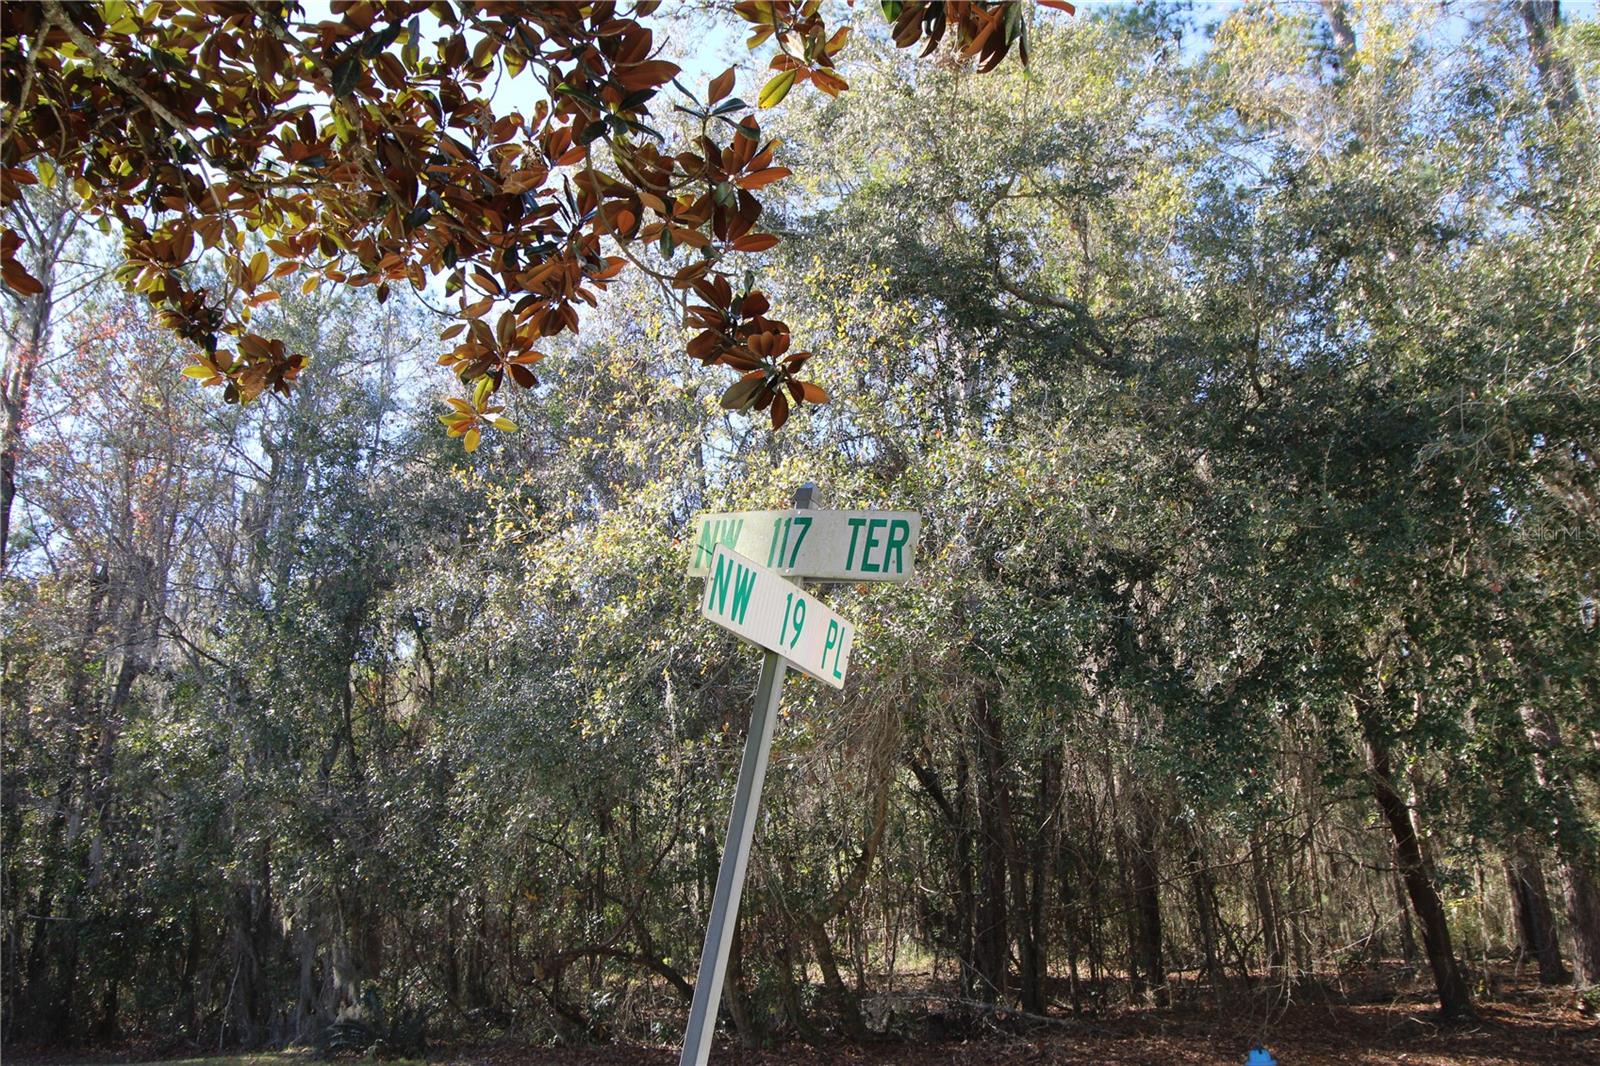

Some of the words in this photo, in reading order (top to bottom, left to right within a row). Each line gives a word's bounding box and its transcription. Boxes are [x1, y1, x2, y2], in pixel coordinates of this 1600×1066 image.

[767, 517, 812, 568] 117
[845, 518, 910, 574] TER
[708, 553, 757, 625] NW
[779, 592, 806, 650] 19
[821, 618, 845, 680] PL
